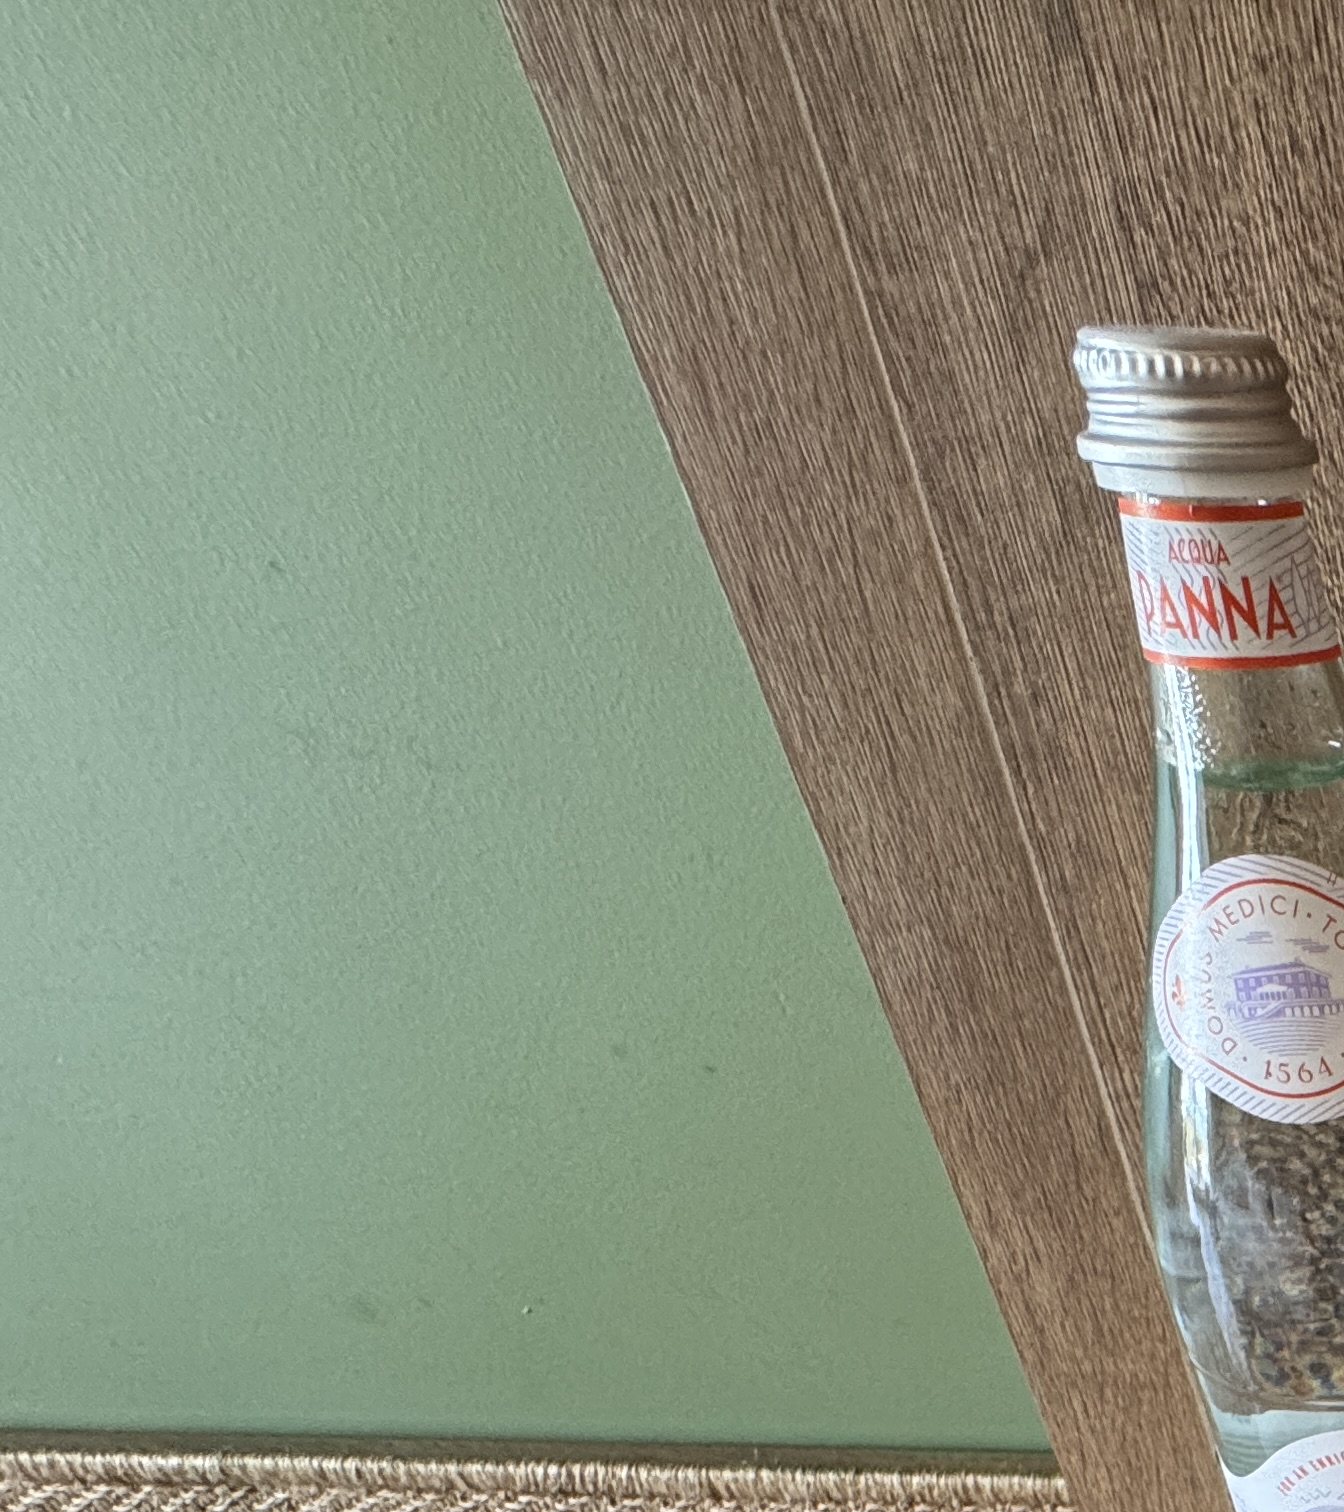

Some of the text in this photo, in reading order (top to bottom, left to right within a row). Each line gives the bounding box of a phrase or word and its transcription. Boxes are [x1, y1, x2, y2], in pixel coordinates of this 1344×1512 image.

[1168, 540, 1231, 566] ACQUA
[1137, 570, 1297, 643] PANNA
[1207, 895, 1299, 943] MEDICI
[1263, 1057, 1334, 1084] 1564
